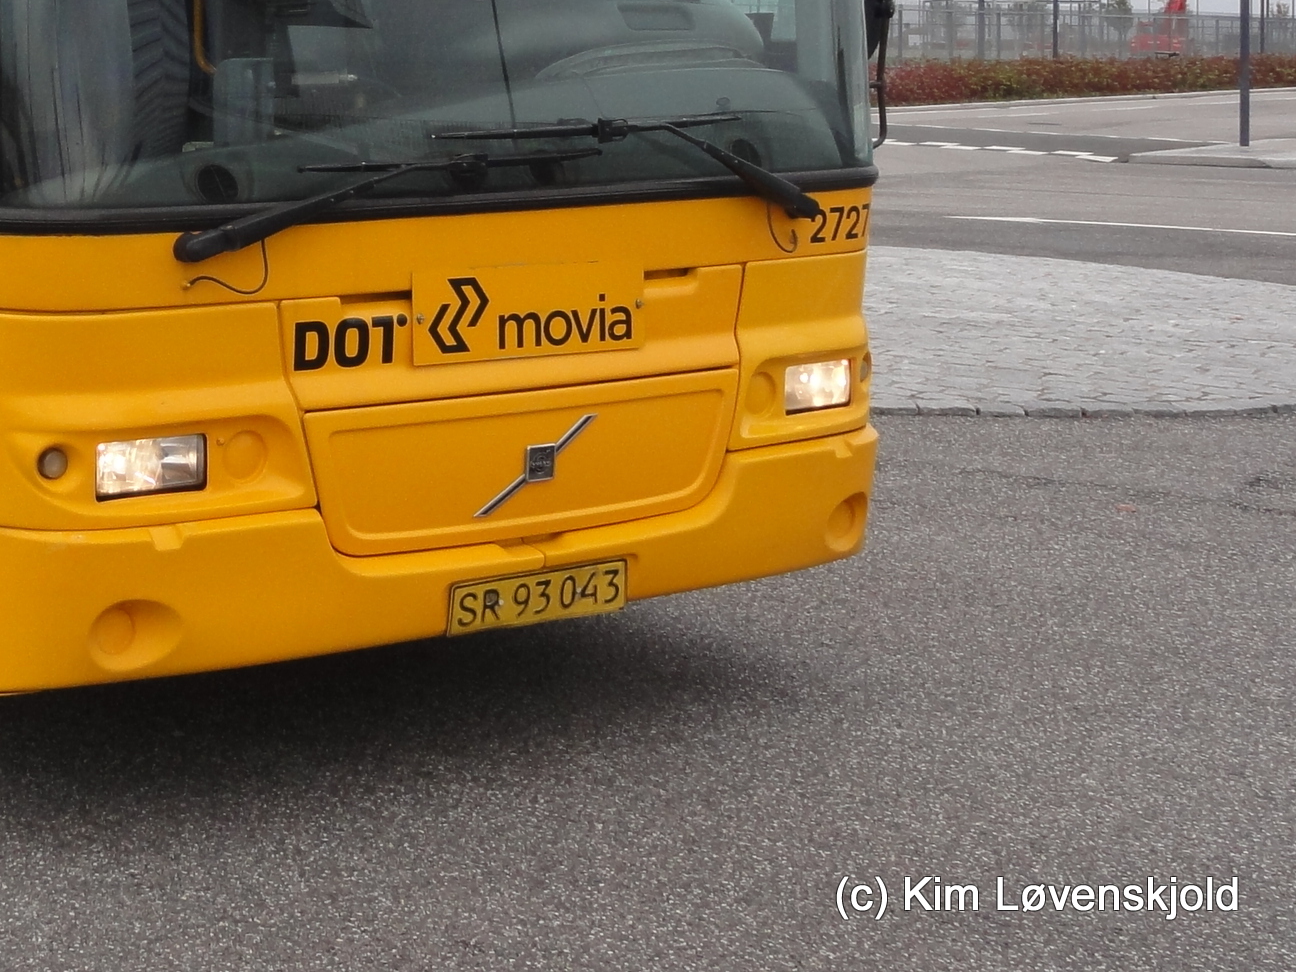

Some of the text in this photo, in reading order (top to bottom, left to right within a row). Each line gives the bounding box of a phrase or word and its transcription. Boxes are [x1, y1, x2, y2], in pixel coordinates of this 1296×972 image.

[810, 202, 870, 243] 2727
[292, 313, 408, 372] DOT
[497, 293, 634, 351] movia
[457, 569, 620, 627] SR 93 043
